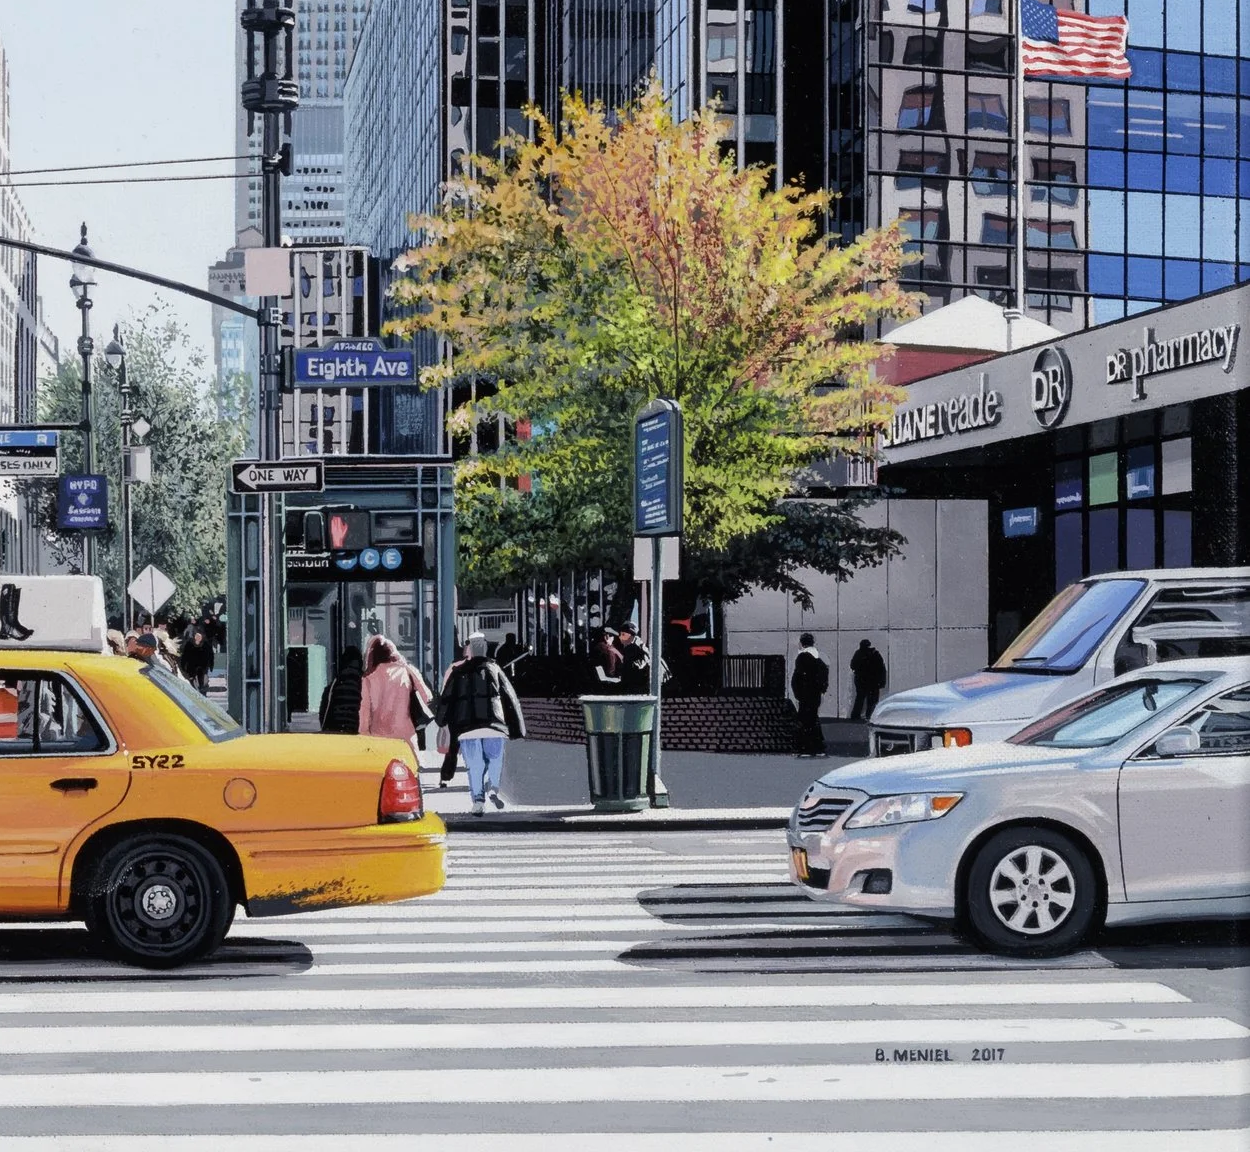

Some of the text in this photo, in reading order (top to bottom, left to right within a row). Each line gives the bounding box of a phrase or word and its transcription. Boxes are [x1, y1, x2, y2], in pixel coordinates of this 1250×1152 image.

[307, 355, 409, 380] Eighth Ave
[1107, 324, 1240, 401] DR pharmacy
[1031, 366, 1065, 411] DR
[249, 469, 309, 482] ONE WAY
[875, 1048, 1005, 1062] B. MENIEL 2017
